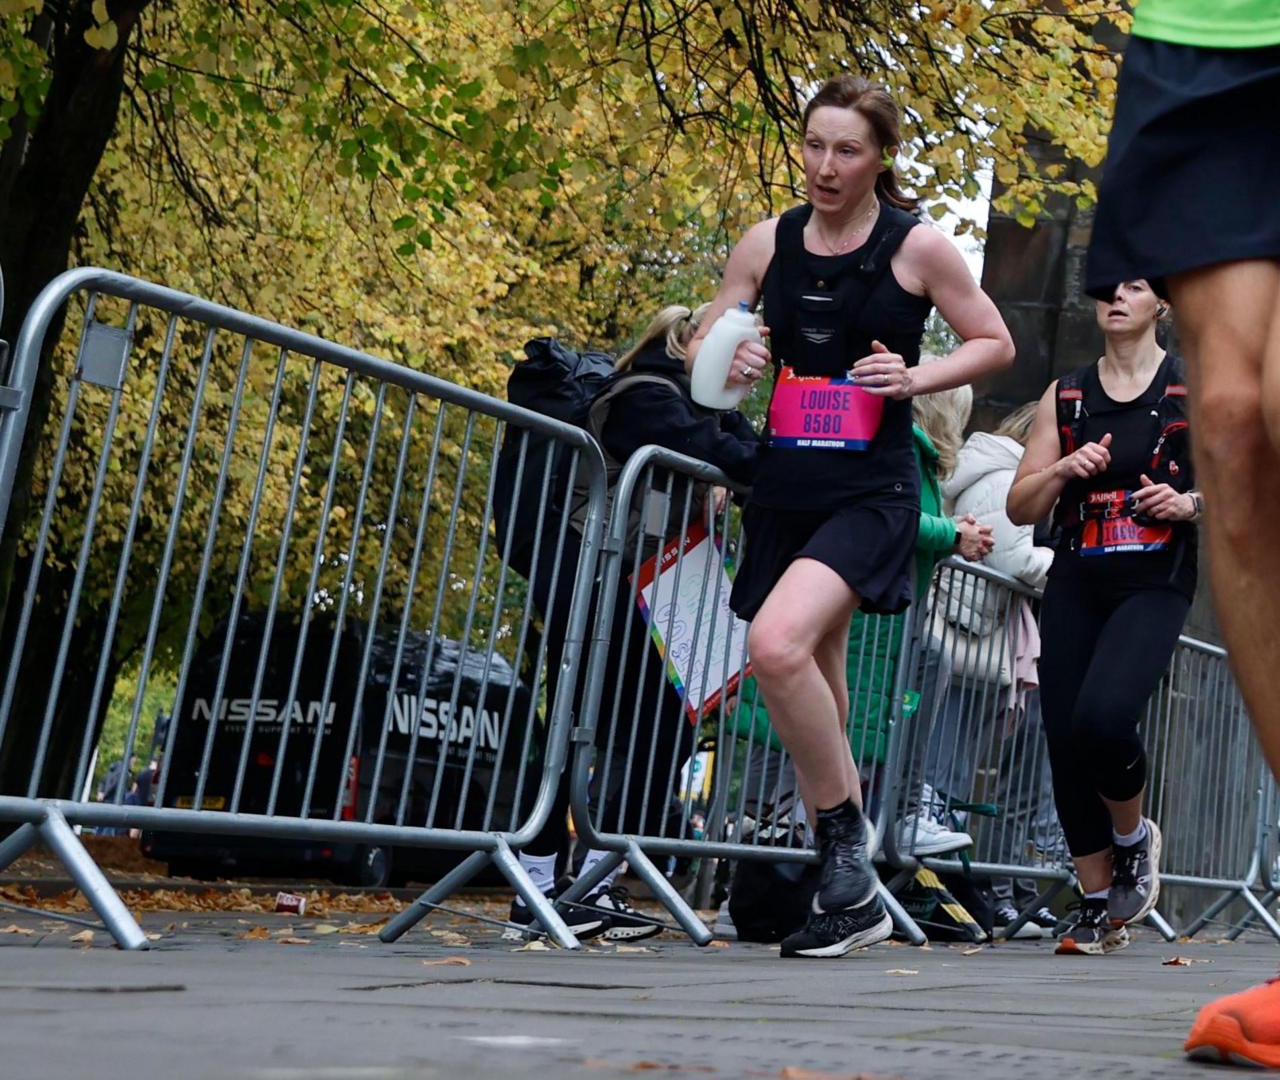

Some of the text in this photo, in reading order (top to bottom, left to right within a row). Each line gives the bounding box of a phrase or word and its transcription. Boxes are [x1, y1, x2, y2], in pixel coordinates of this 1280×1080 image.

[800, 390, 851, 413] LOUISE
[803, 413, 842, 435] 8580
[811, 439, 845, 448] MARATHON
[191, 698, 337, 725] NISSAN
[387, 691, 500, 749] NISSAN
